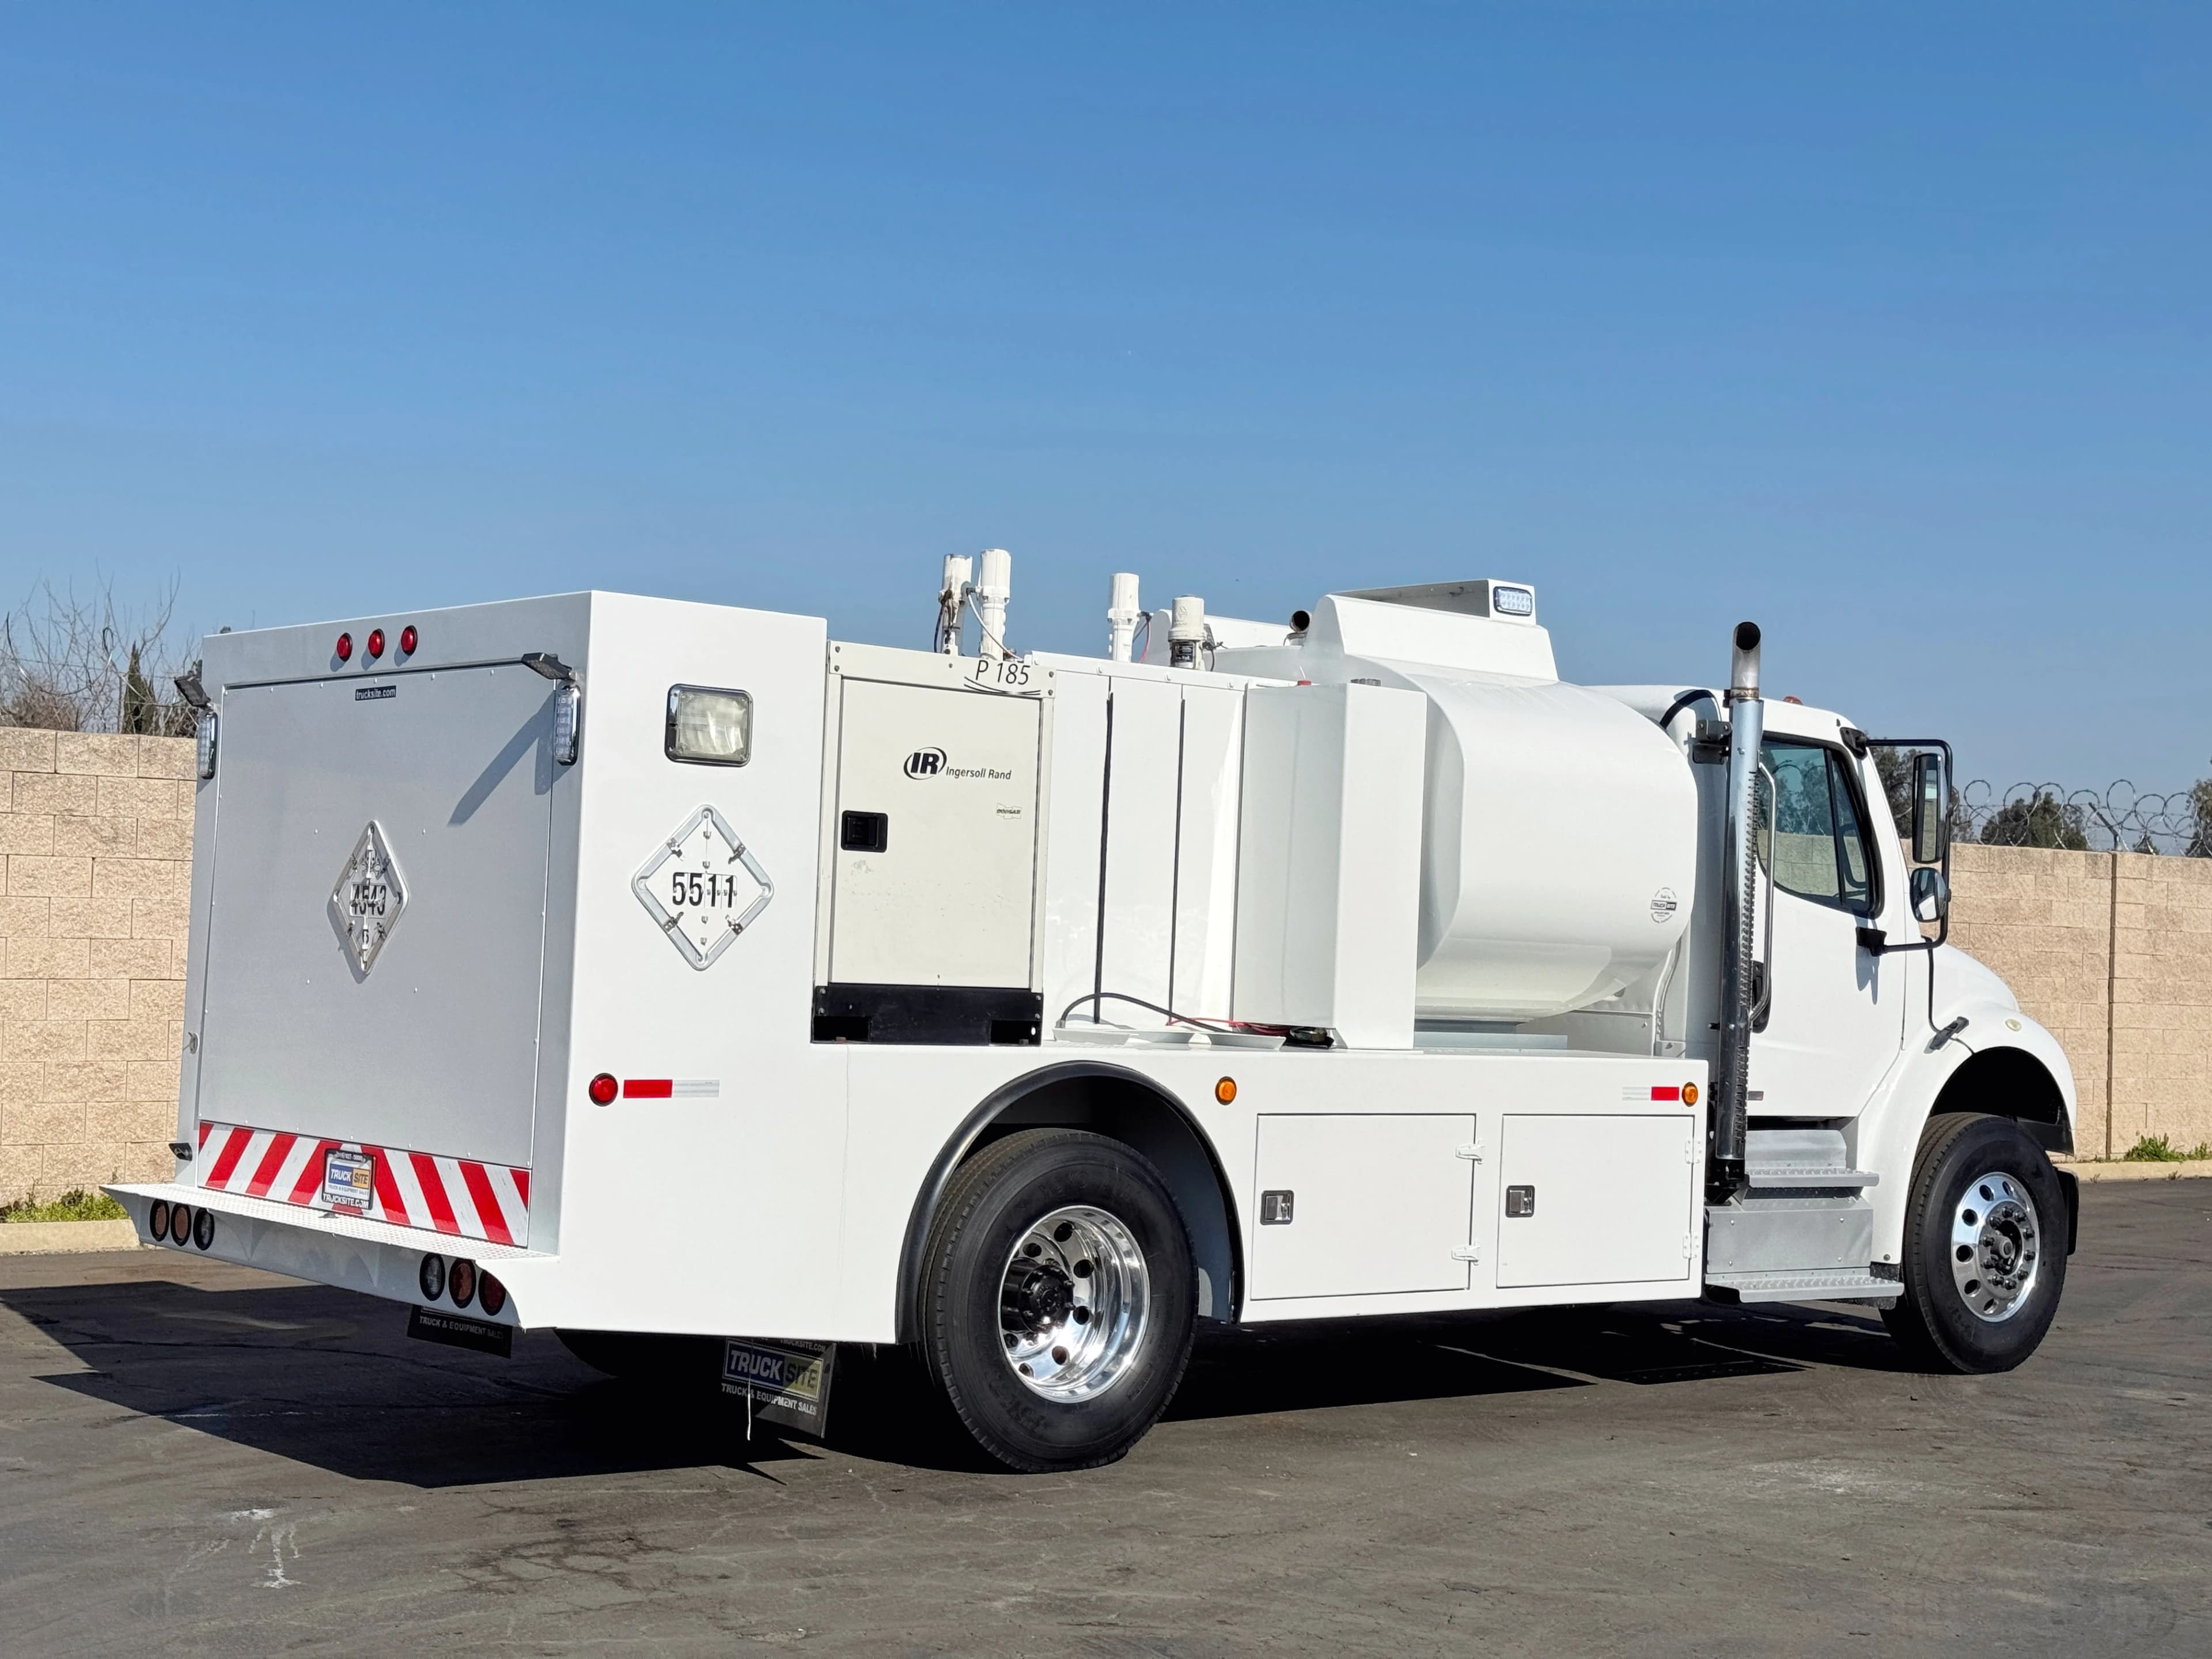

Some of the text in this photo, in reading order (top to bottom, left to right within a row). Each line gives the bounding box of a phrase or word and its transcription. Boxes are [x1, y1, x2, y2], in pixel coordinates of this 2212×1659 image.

[976, 660, 1031, 685] P 185
[357, 688, 396, 700] trucksite.com
[911, 752, 1012, 780] IR Ingersoll Rand
[672, 872, 733, 908] 5511
[331, 1169, 369, 1184] TRUCK SITE
[419, 1316, 441, 1328] TRUCK
[442, 1320, 448, 1328] &
[449, 1322, 486, 1335] EQUIPMENT
[730, 1350, 818, 1389] TRUCK SITE
[721, 1383, 747, 1397] TRUCK
[756, 1391, 798, 1410] EQUIPMENT
[798, 1401, 817, 1416] SALES
